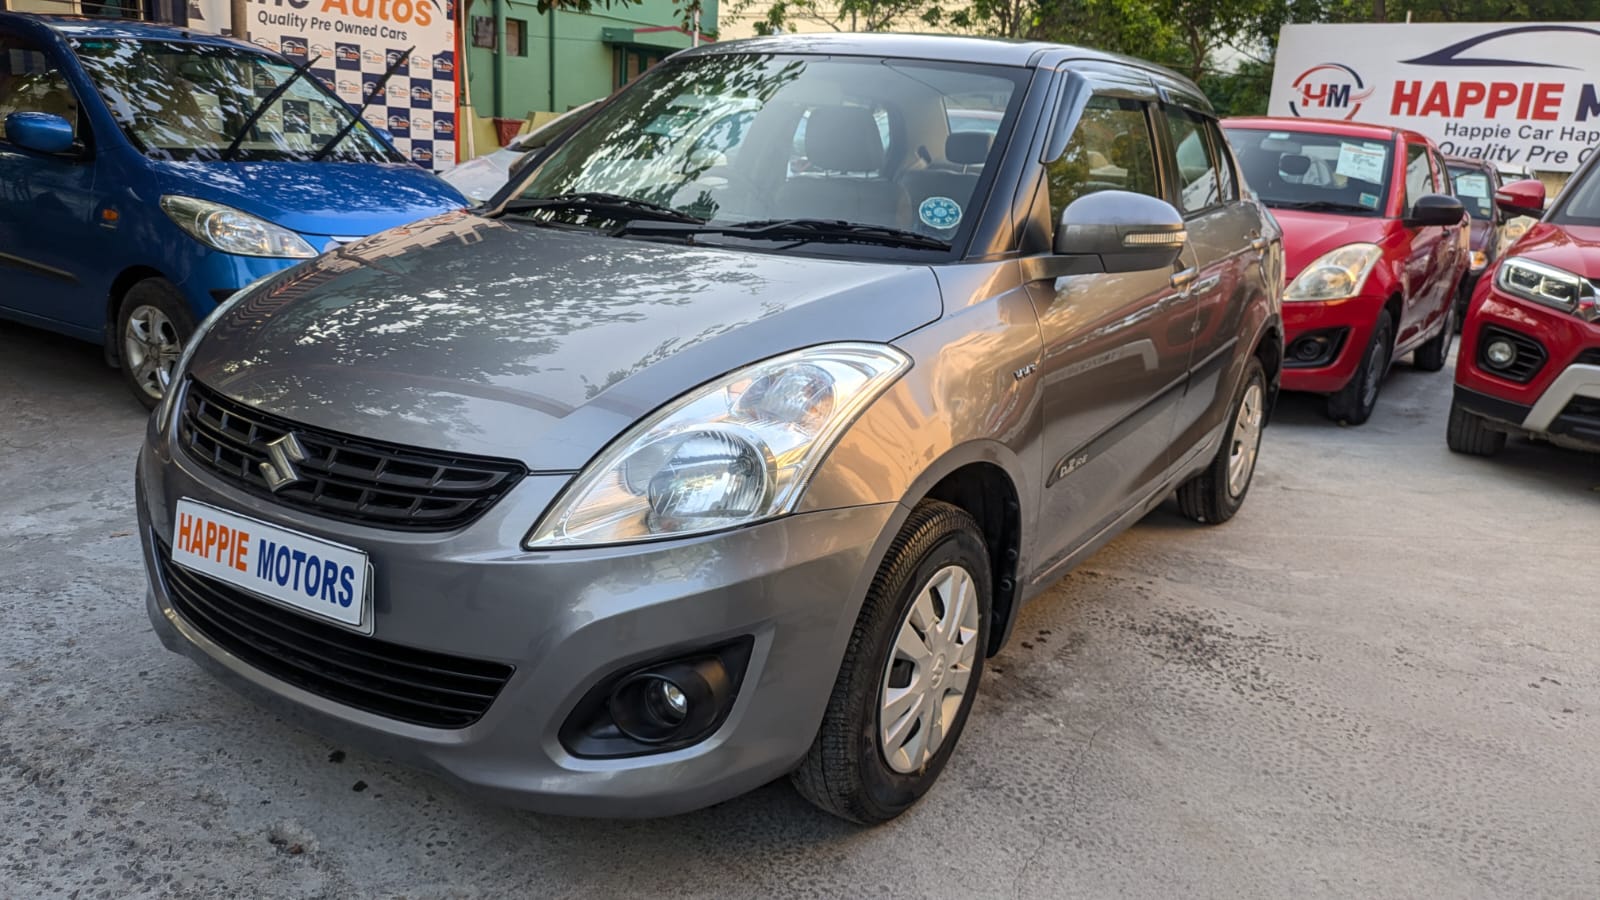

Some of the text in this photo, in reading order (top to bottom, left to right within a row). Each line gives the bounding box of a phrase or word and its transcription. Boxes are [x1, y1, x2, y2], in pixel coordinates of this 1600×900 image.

[258, 10, 408, 41] Quality Pre Owned Cars
[1301, 83, 1351, 108] HM
[1390, 80, 1565, 121] HAPPIE
[1444, 122, 1511, 141] Happie
[1518, 124, 1553, 140] Car
[1439, 141, 1519, 163] Quality
[1525, 145, 1569, 164] Pre
[177, 512, 355, 608] HAPPIE MOTORS
